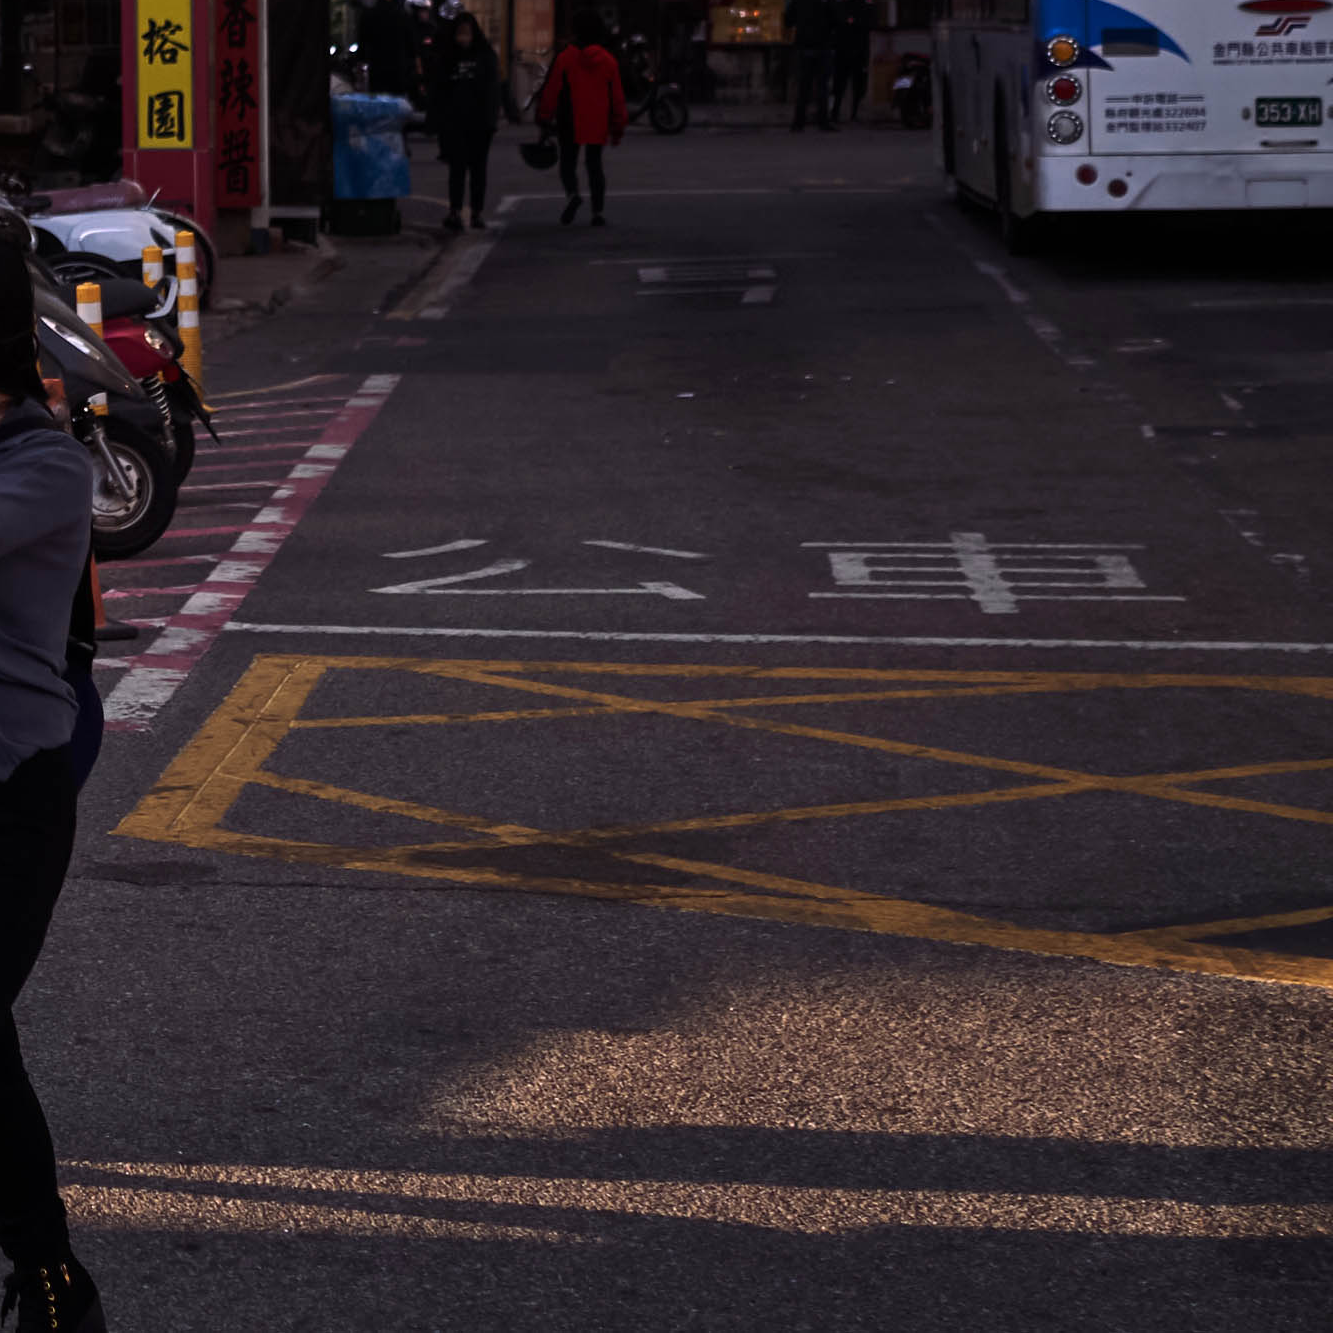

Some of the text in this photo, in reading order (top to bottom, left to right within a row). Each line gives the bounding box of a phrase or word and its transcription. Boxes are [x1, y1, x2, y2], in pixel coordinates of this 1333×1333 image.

[1212, 41, 1333, 58] 金門縣公共車船管
